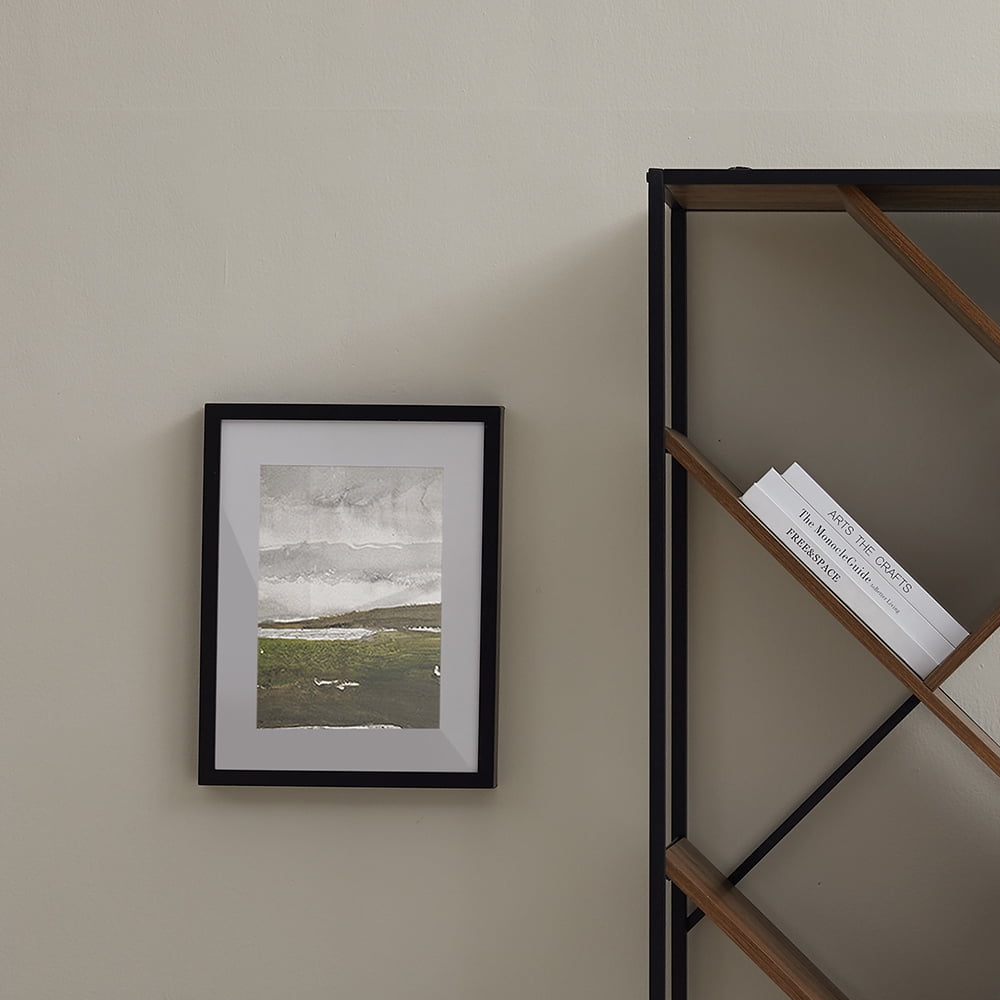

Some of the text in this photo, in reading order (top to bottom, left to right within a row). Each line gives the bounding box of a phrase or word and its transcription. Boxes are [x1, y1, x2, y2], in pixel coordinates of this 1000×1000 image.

[799, 508, 815, 529] The
[786, 528, 841, 583] FREE&SPACE
[827, 510, 913, 594] ARTS THE CRAFTS
